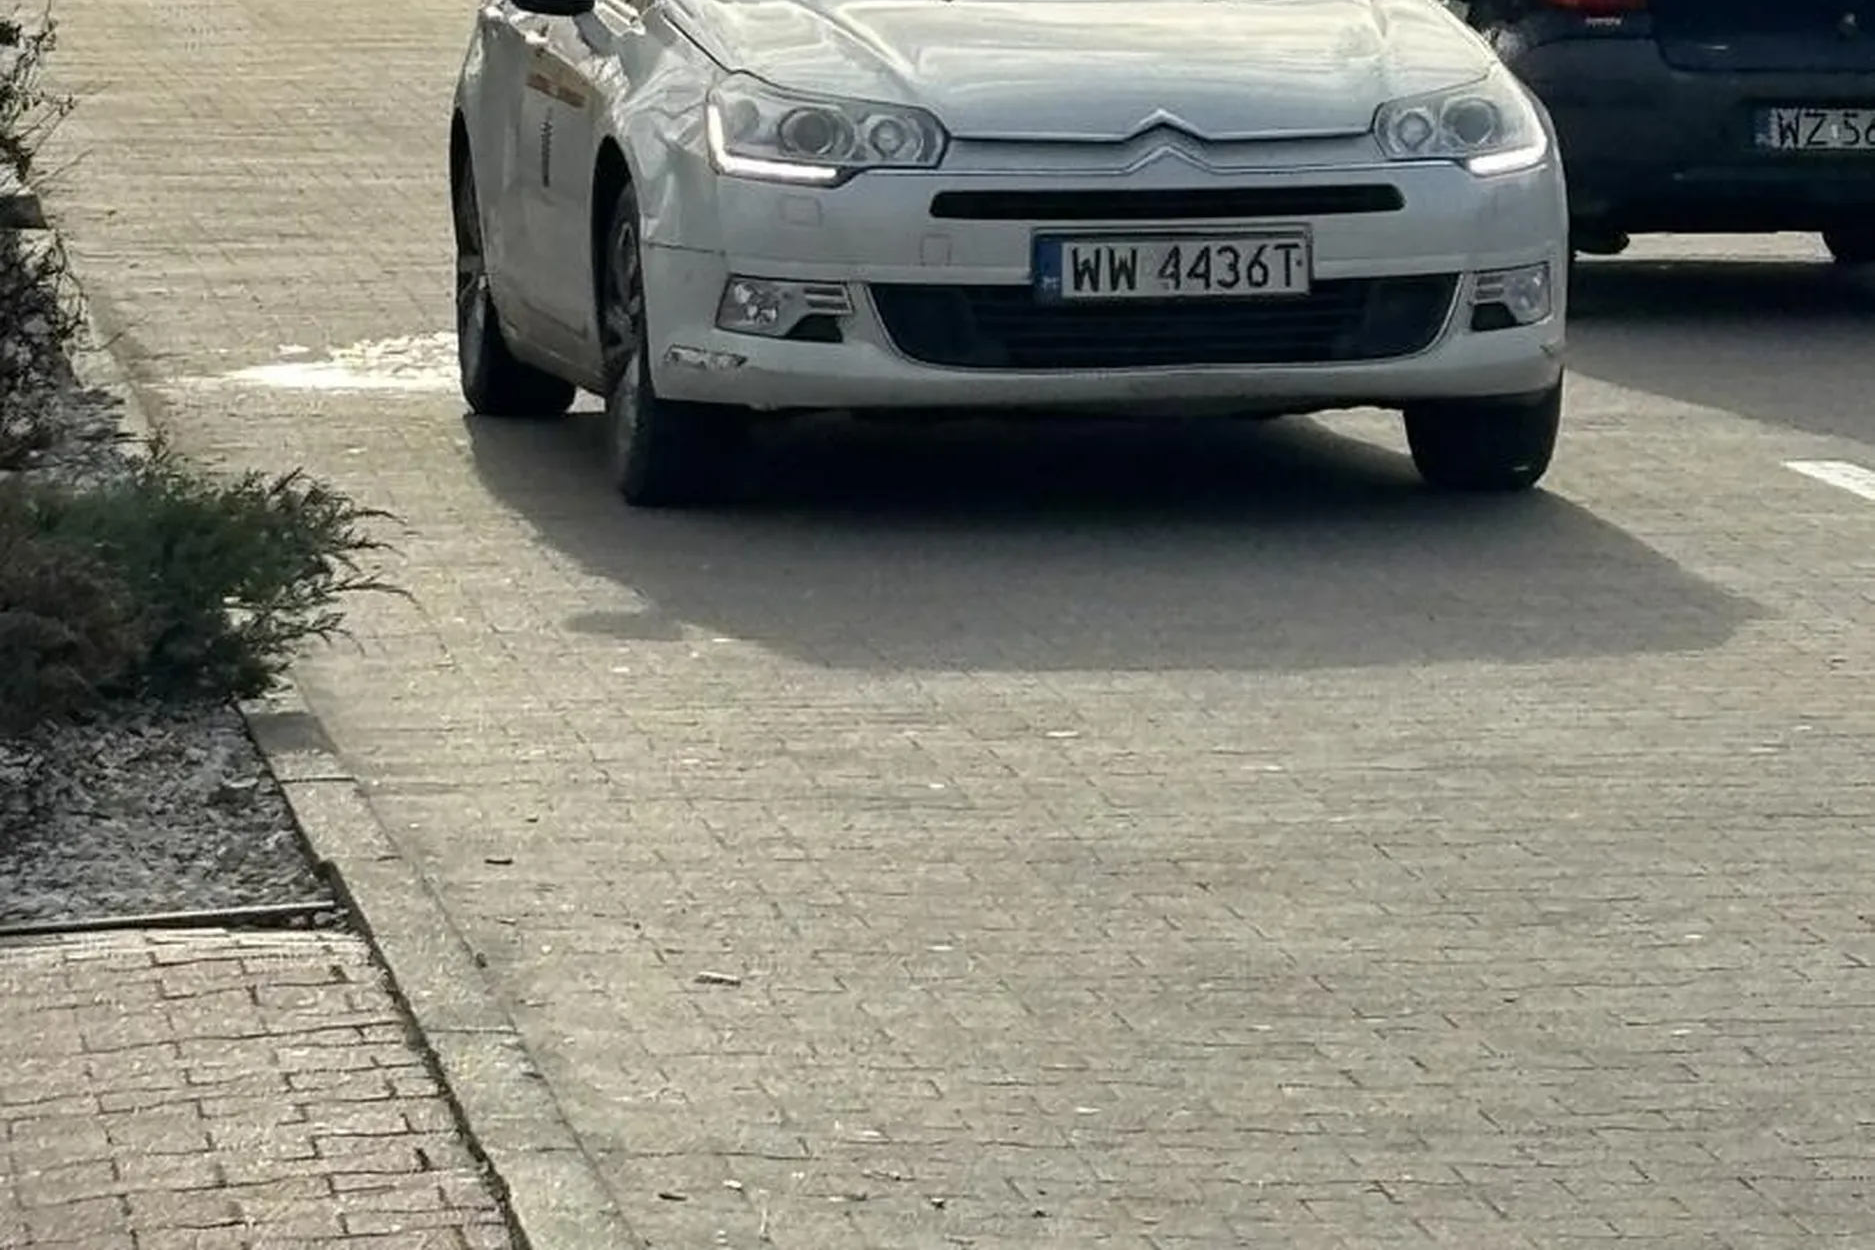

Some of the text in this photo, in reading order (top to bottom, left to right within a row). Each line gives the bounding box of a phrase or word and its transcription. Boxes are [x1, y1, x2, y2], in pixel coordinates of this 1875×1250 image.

[1776, 111, 1828, 147] WZ
[1071, 242, 1301, 292] WW 4436T
